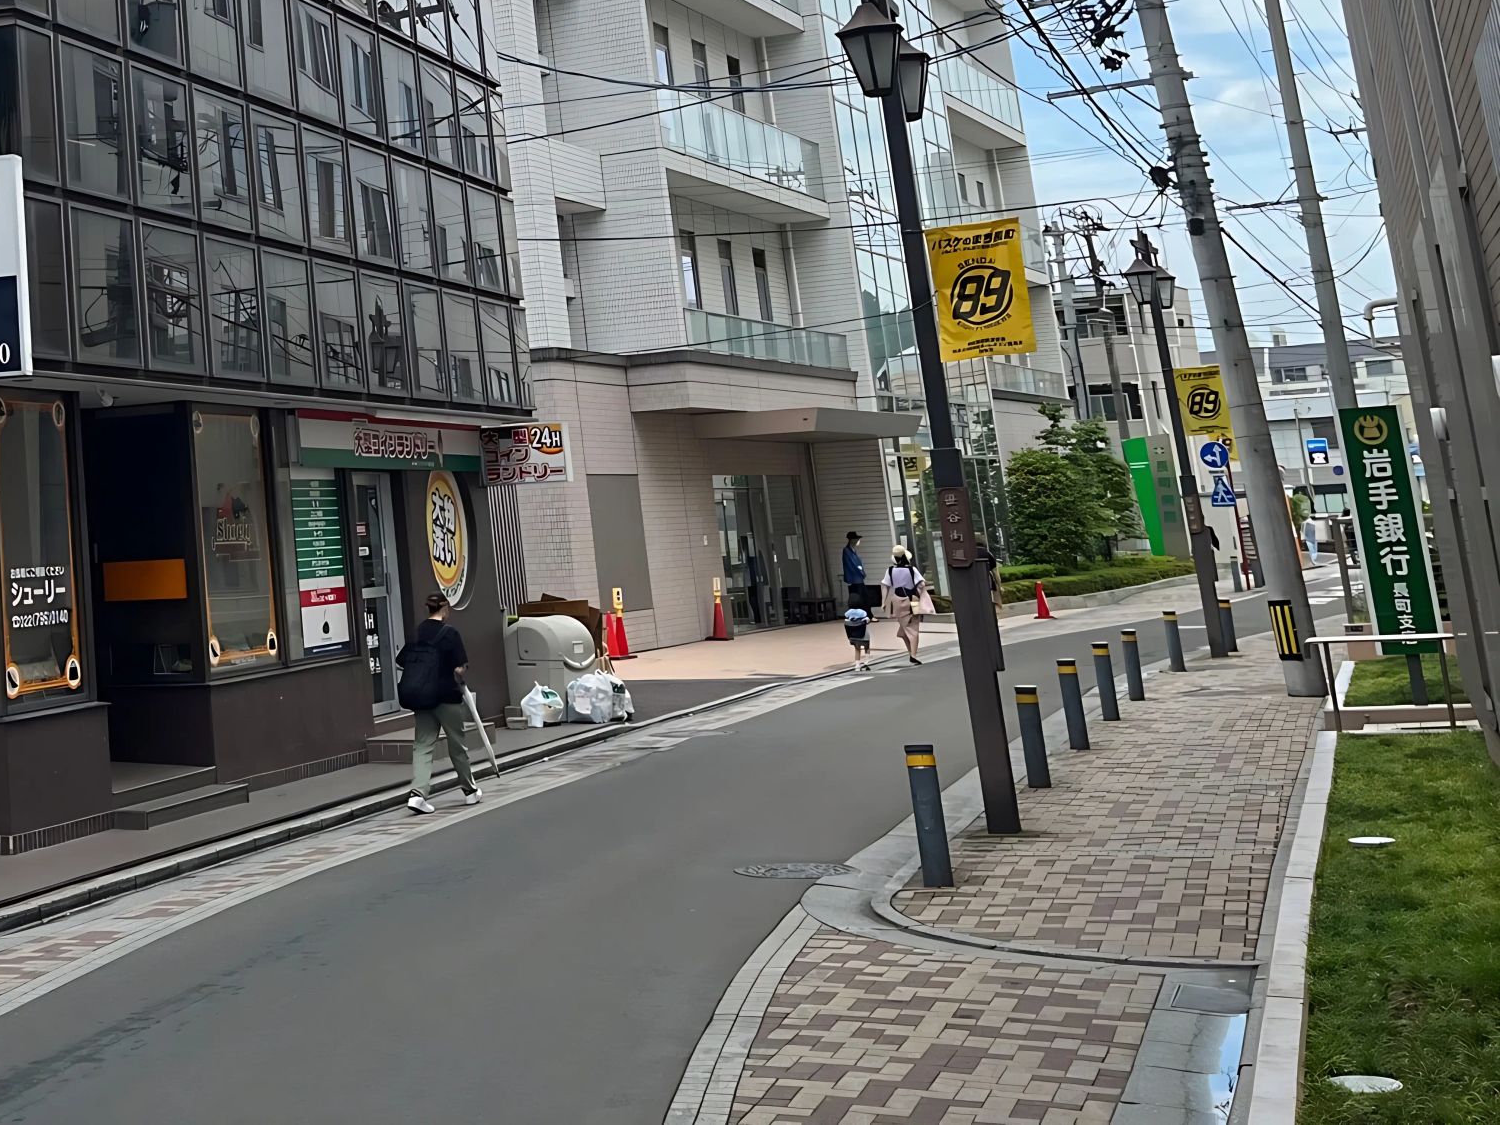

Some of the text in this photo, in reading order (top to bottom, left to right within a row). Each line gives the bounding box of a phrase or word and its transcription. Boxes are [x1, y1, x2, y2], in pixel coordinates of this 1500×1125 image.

[952, 269, 1011, 320] 89
[531, 426, 562, 448] 24H
[484, 446, 531, 466] コイン
[486, 464, 565, 483] ランドリー
[1362, 448, 1411, 576] 岩手銀行
[11, 579, 66, 607] シューリー
